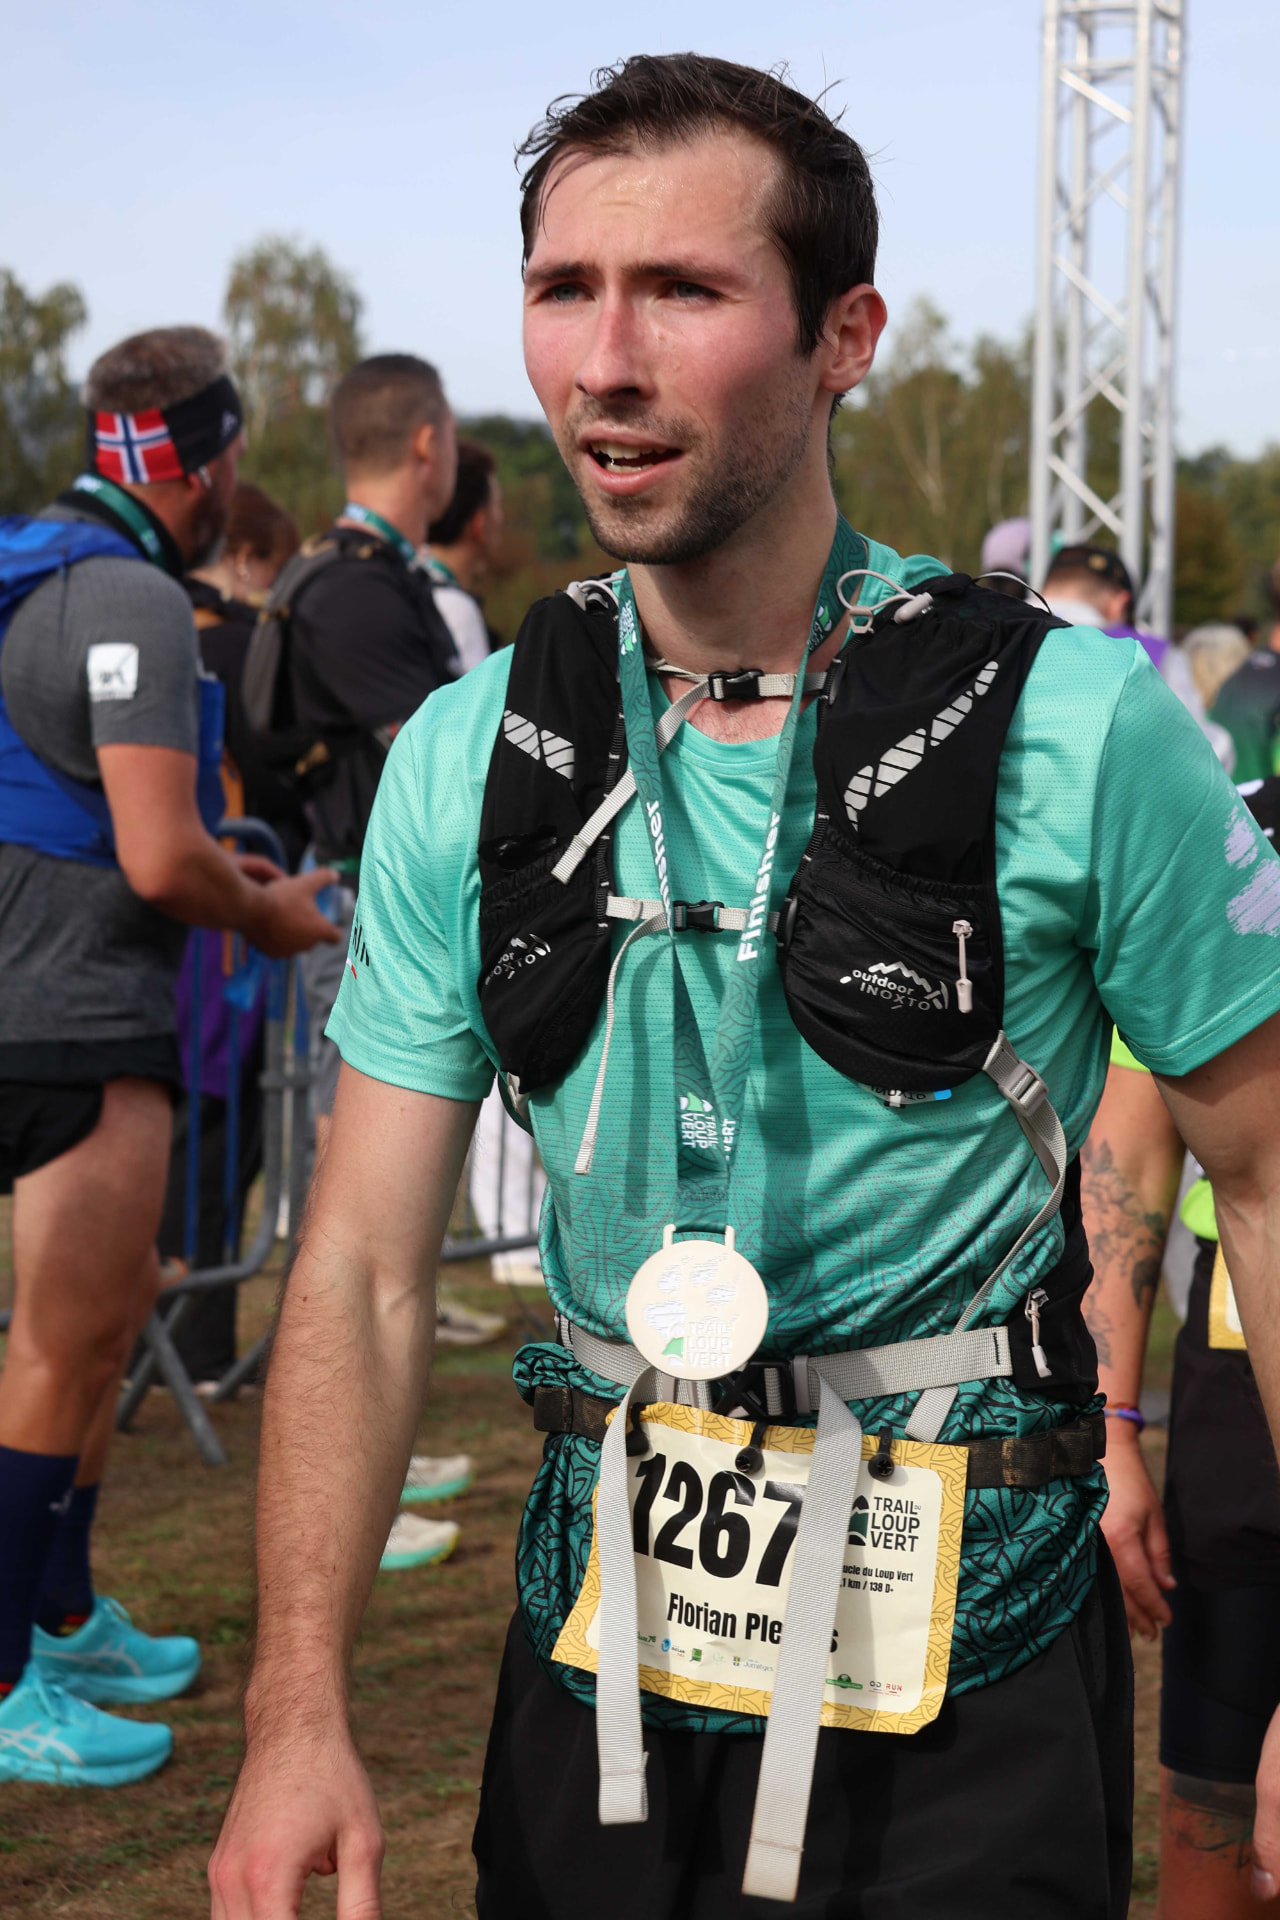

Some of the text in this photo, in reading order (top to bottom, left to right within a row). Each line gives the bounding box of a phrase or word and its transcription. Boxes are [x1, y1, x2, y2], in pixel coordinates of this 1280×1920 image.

[737, 811, 780, 961] Finisher
[852, 969, 915, 995] outdoor
[860, 982, 931, 1011] INOXTO
[681, 1113, 697, 1148] VERT
[694, 1113, 709, 1149] LOUP
[705, 1115, 719, 1147] TRAIL
[688, 1321, 728, 1335] TRAIL
[688, 1336, 731, 1350] LOUP
[687, 1352, 732, 1368] VERT
[874, 1496, 918, 1515] TRAIL
[633, 1453, 806, 1587] 1267
[871, 1513, 920, 1533] LOUP
[870, 1531, 919, 1552] VERT
[842, 1565, 913, 1582] ucle du Loup Vert
[848, 1579, 861, 1589] km
[870, 1582, 882, 1591] 138
[667, 1592, 736, 1638] Florian
[886, 1683, 902, 1691] RUN
